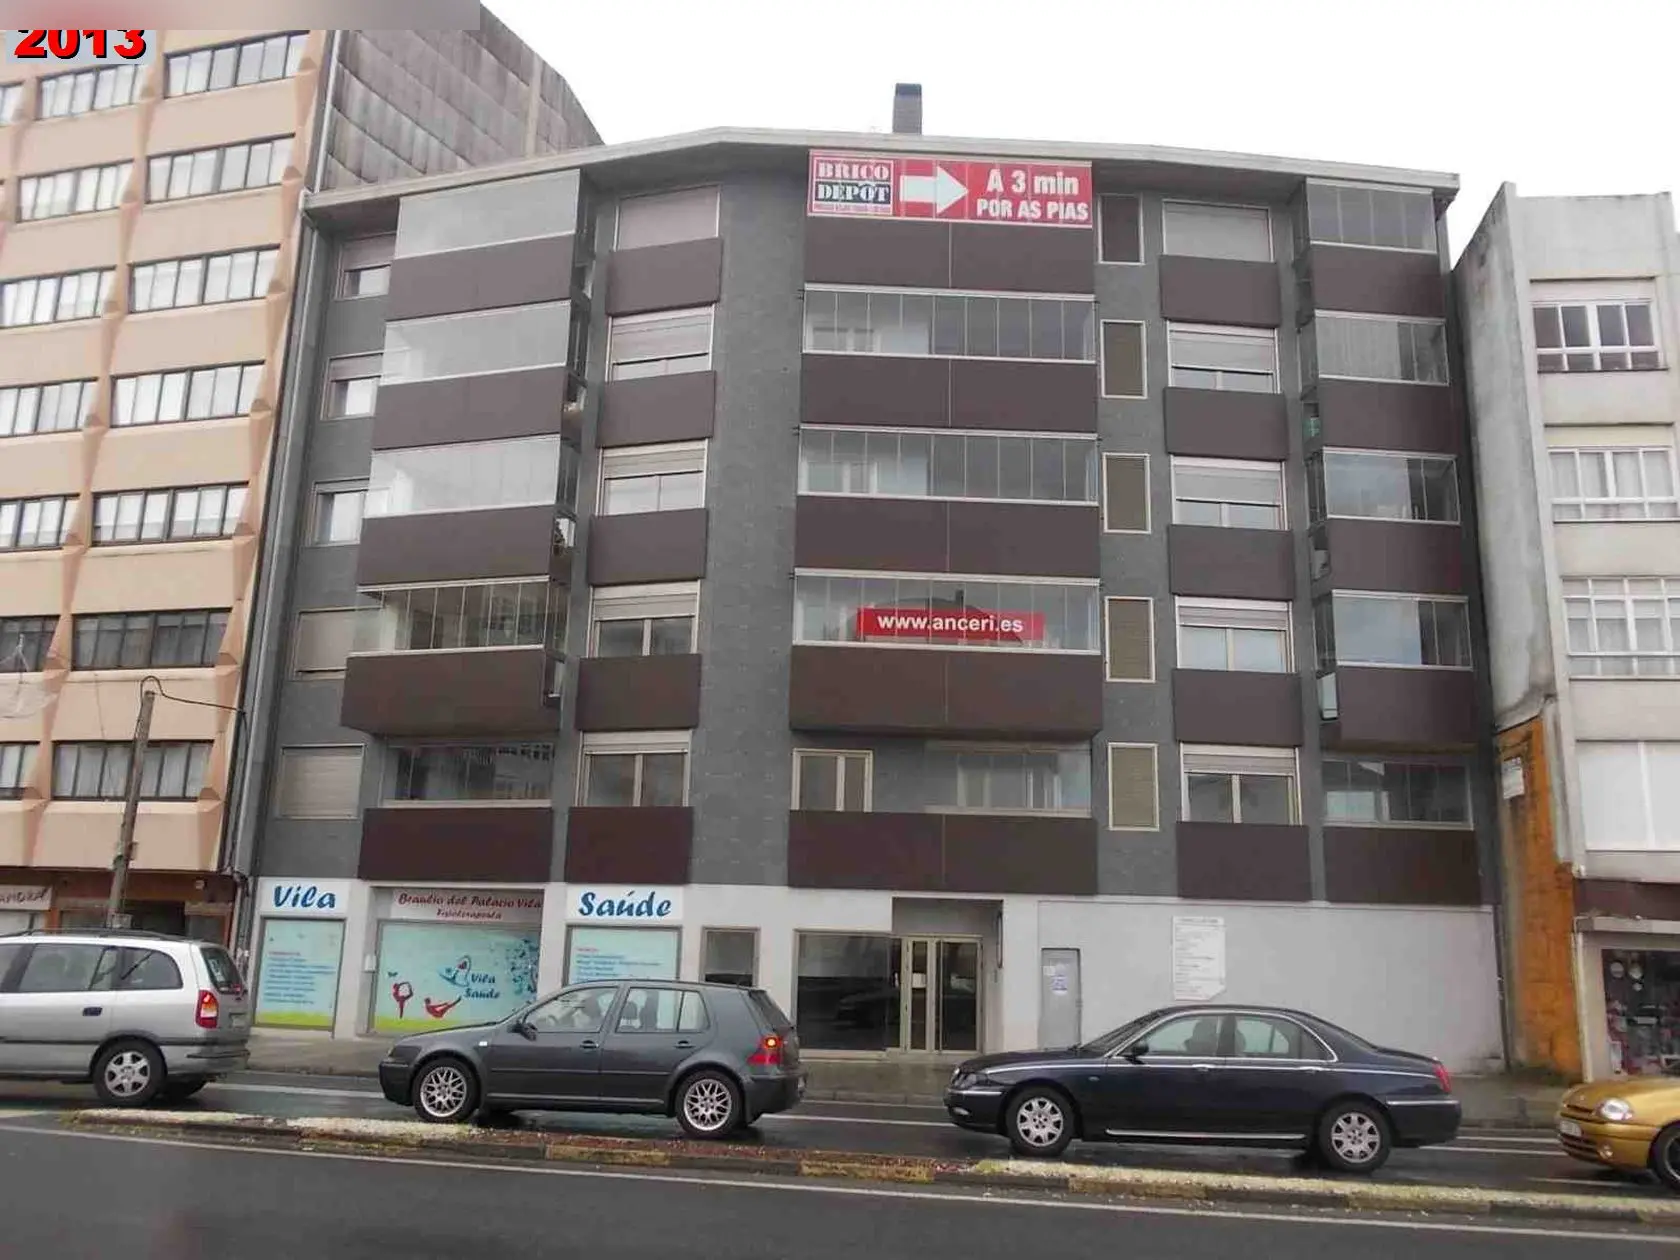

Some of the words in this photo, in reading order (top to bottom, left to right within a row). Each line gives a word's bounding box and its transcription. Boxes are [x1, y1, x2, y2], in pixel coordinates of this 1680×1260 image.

[817, 161, 890, 180] BRICO
[1011, 169, 1026, 193] 3
[1033, 170, 1079, 195] min
[976, 198, 1012, 218] POR
[1017, 200, 1042, 219] AS
[1046, 201, 1089, 220] PIAS
[877, 614, 1024, 633] www.anceri.es
[273, 885, 336, 909] Vila
[446, 894, 466, 906] del
[471, 895, 514, 908] Palacio
[516, 896, 542, 908] Vila
[578, 890, 672, 917] Saúde
[471, 972, 496, 984] Vila
